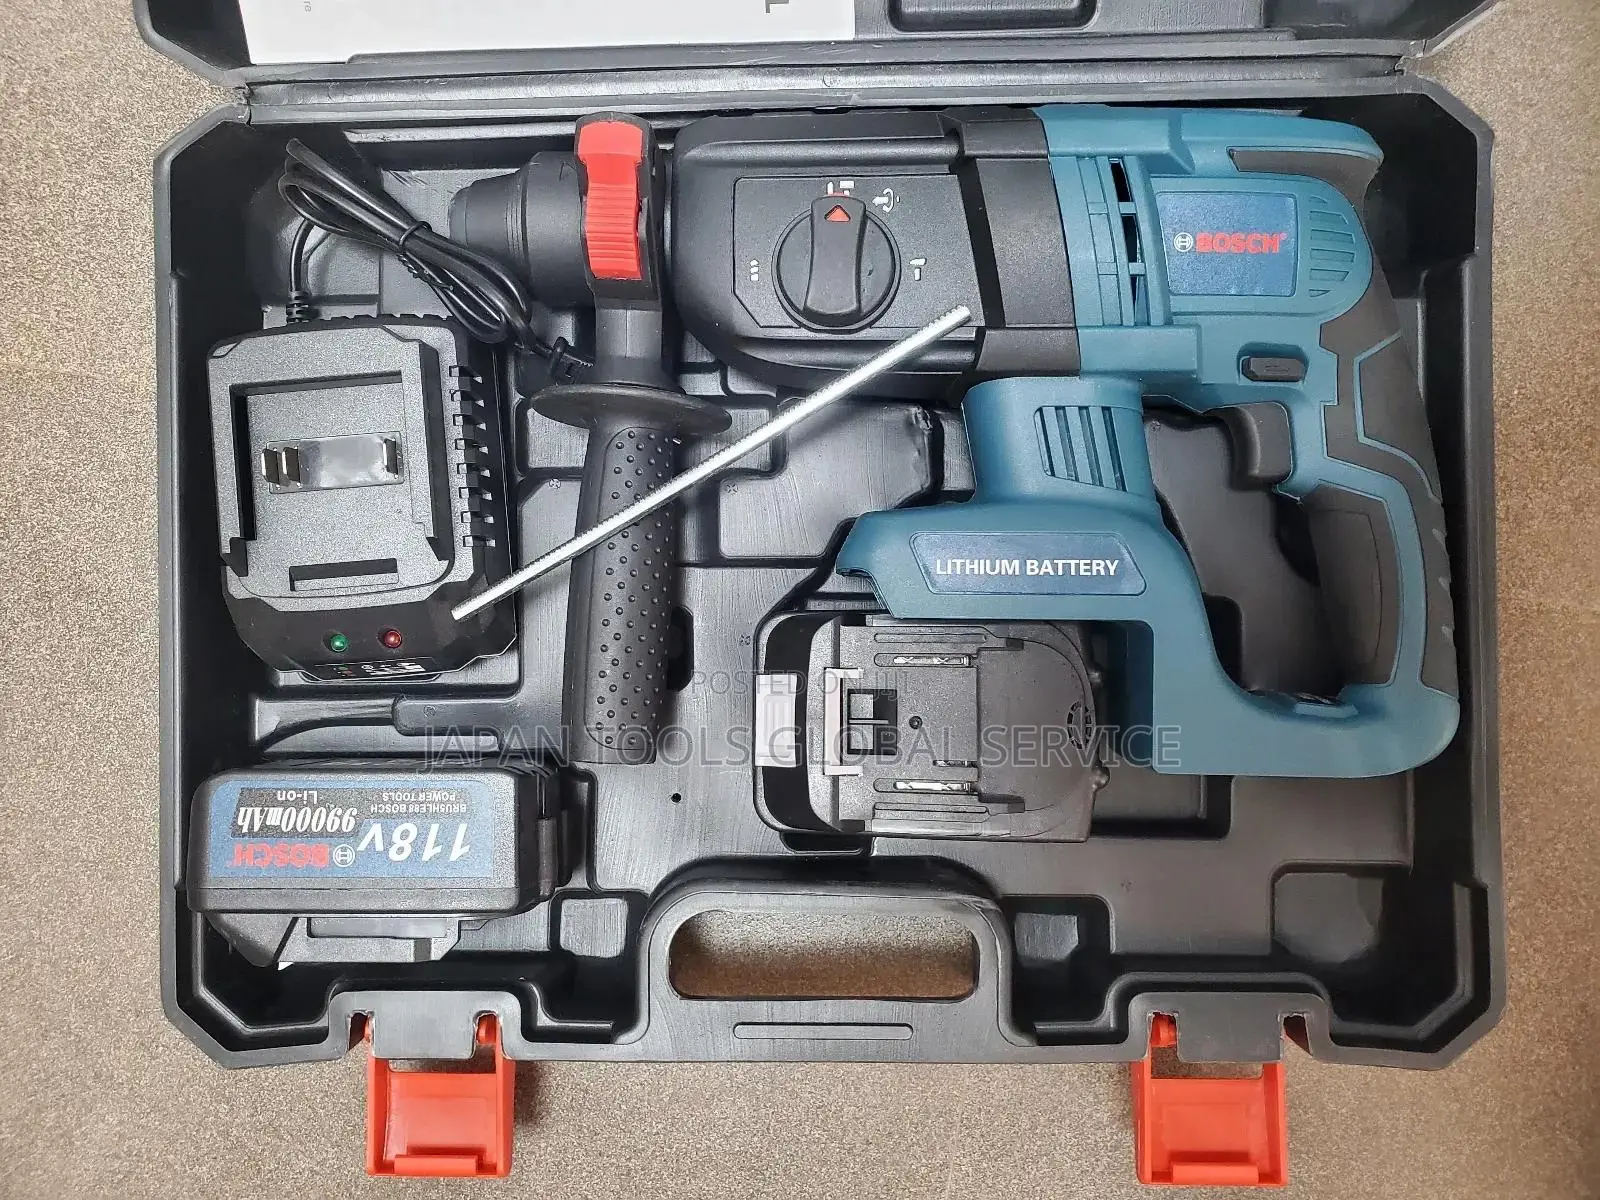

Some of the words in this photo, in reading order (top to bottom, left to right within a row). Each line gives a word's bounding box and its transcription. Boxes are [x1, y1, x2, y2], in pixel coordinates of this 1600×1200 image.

[1195, 231, 1281, 254] BOSCH
[936, 559, 1020, 576] LITHIUM
[1026, 559, 1120, 576] BATTERY
[276, 790, 318, 805] Li-on
[382, 791, 416, 802] TOOLS
[418, 791, 456, 802] POWER
[370, 803, 406, 814] BOSCH
[237, 806, 358, 833] 99000mAh
[233, 841, 330, 869] BOSCH
